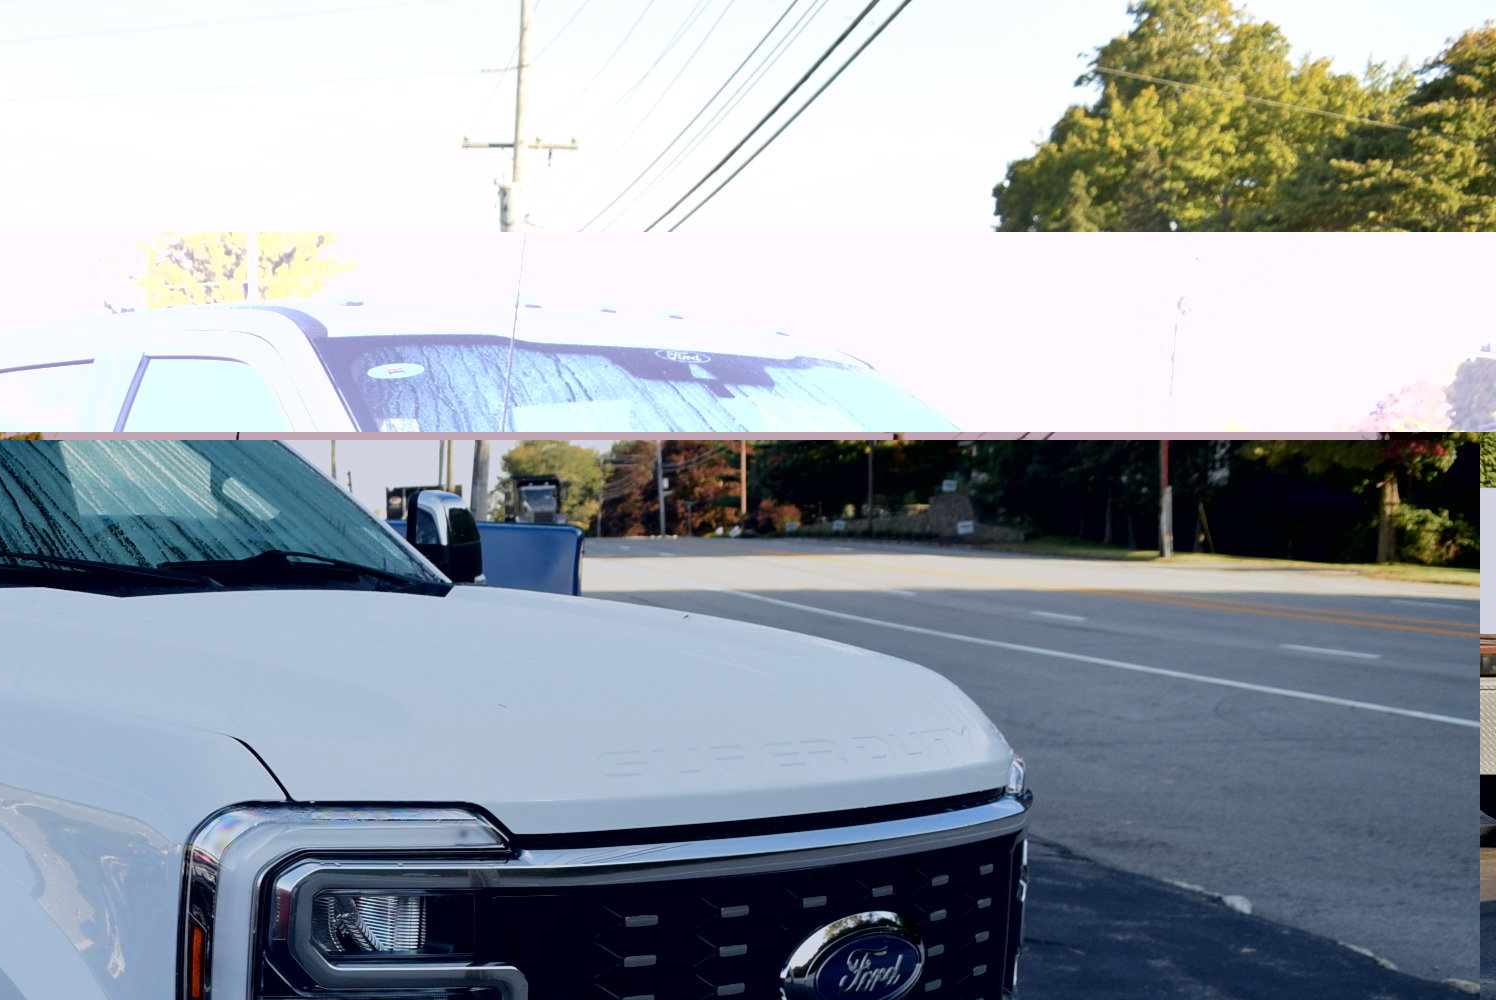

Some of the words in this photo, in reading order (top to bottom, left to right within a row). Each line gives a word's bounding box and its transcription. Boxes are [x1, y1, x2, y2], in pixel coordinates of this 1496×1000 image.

[597, 738, 847, 778] SUPER
[850, 725, 967, 762] DUTY
[838, 946, 904, 992] Ford
